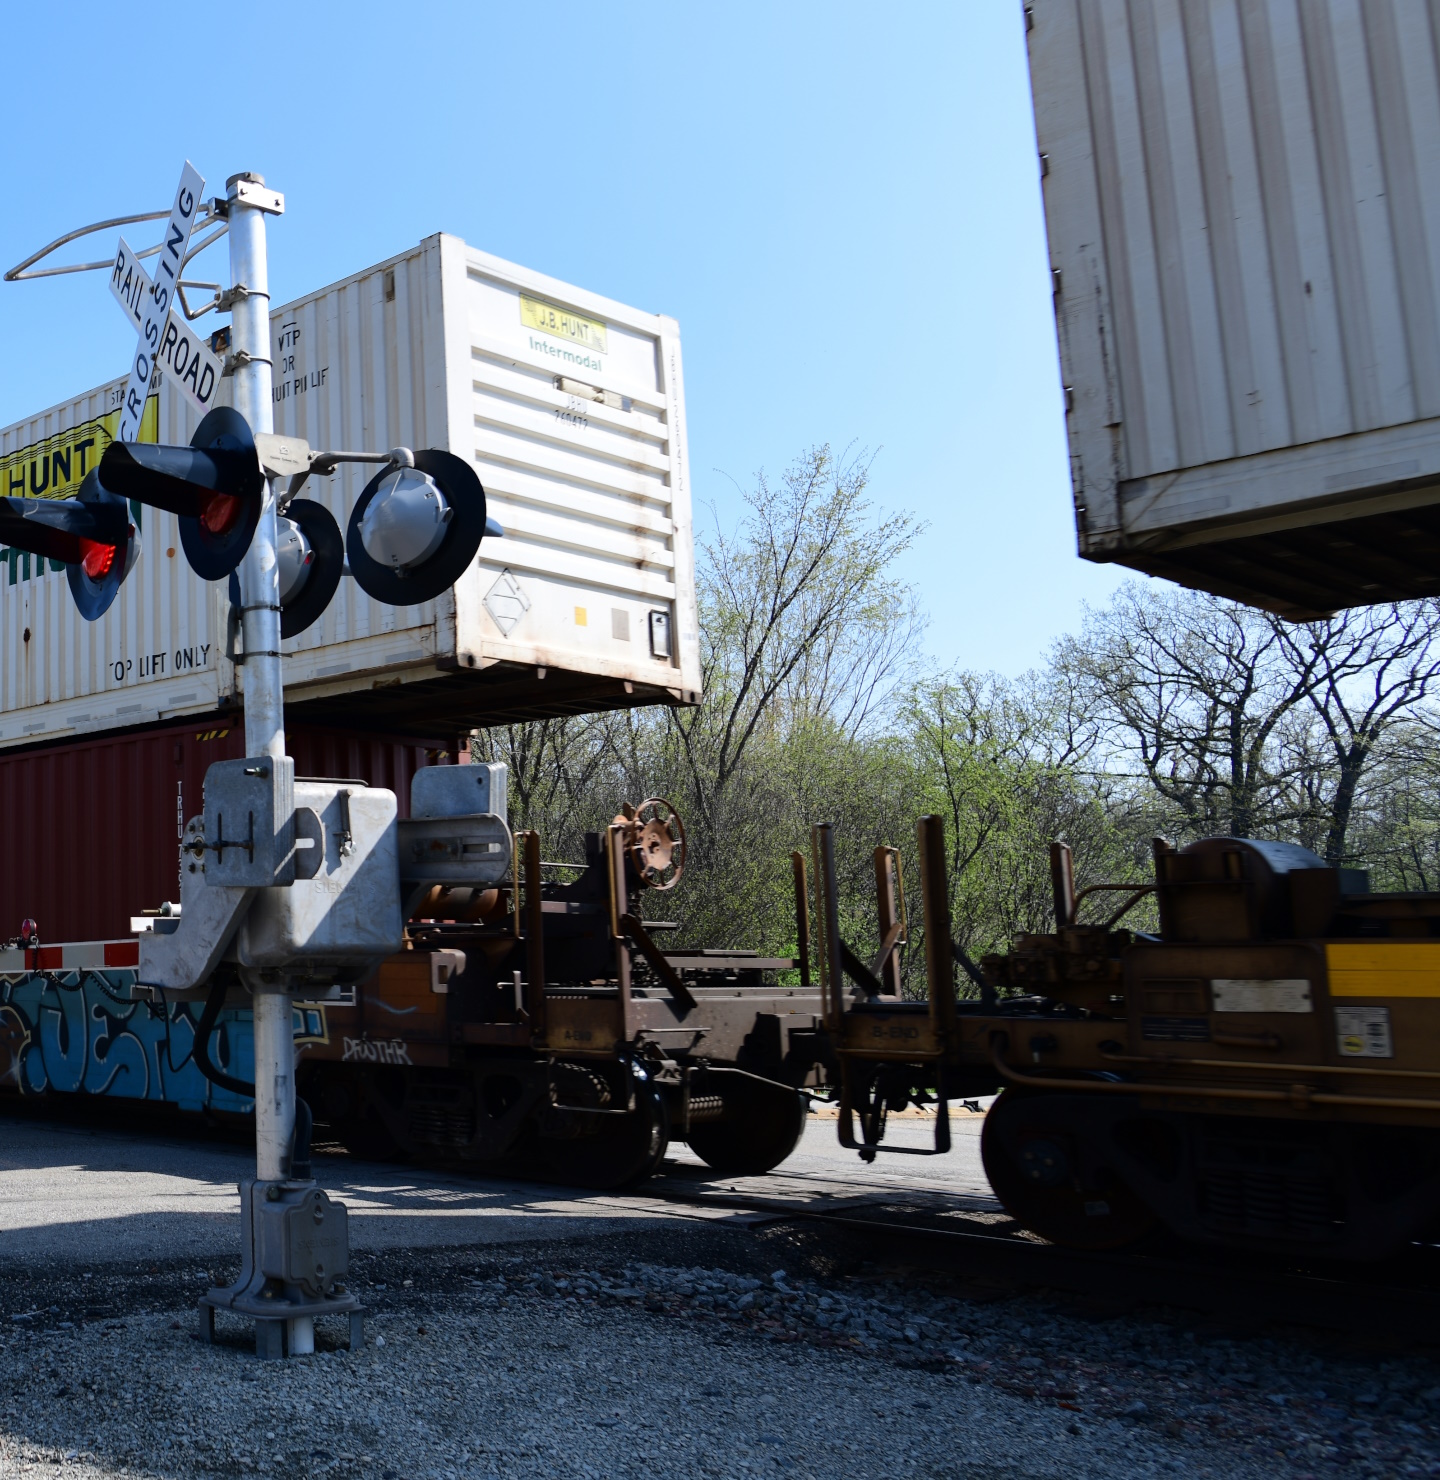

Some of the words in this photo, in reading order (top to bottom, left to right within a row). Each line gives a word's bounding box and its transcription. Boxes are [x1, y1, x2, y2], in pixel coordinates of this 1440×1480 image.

[113, 250, 143, 321] RAIL
[161, 321, 216, 405] ROAD
[120, 186, 194, 442] CROSSING
[561, 315, 589, 341] HUNT
[529, 336, 602, 372] Intermodal
[111, 389, 126, 406] STA
[9, 437, 95, 498] HUNT
[139, 651, 167, 677] LIFT
[175, 643, 211, 671] ONLY
[176, 780, 184, 839] TRHU
